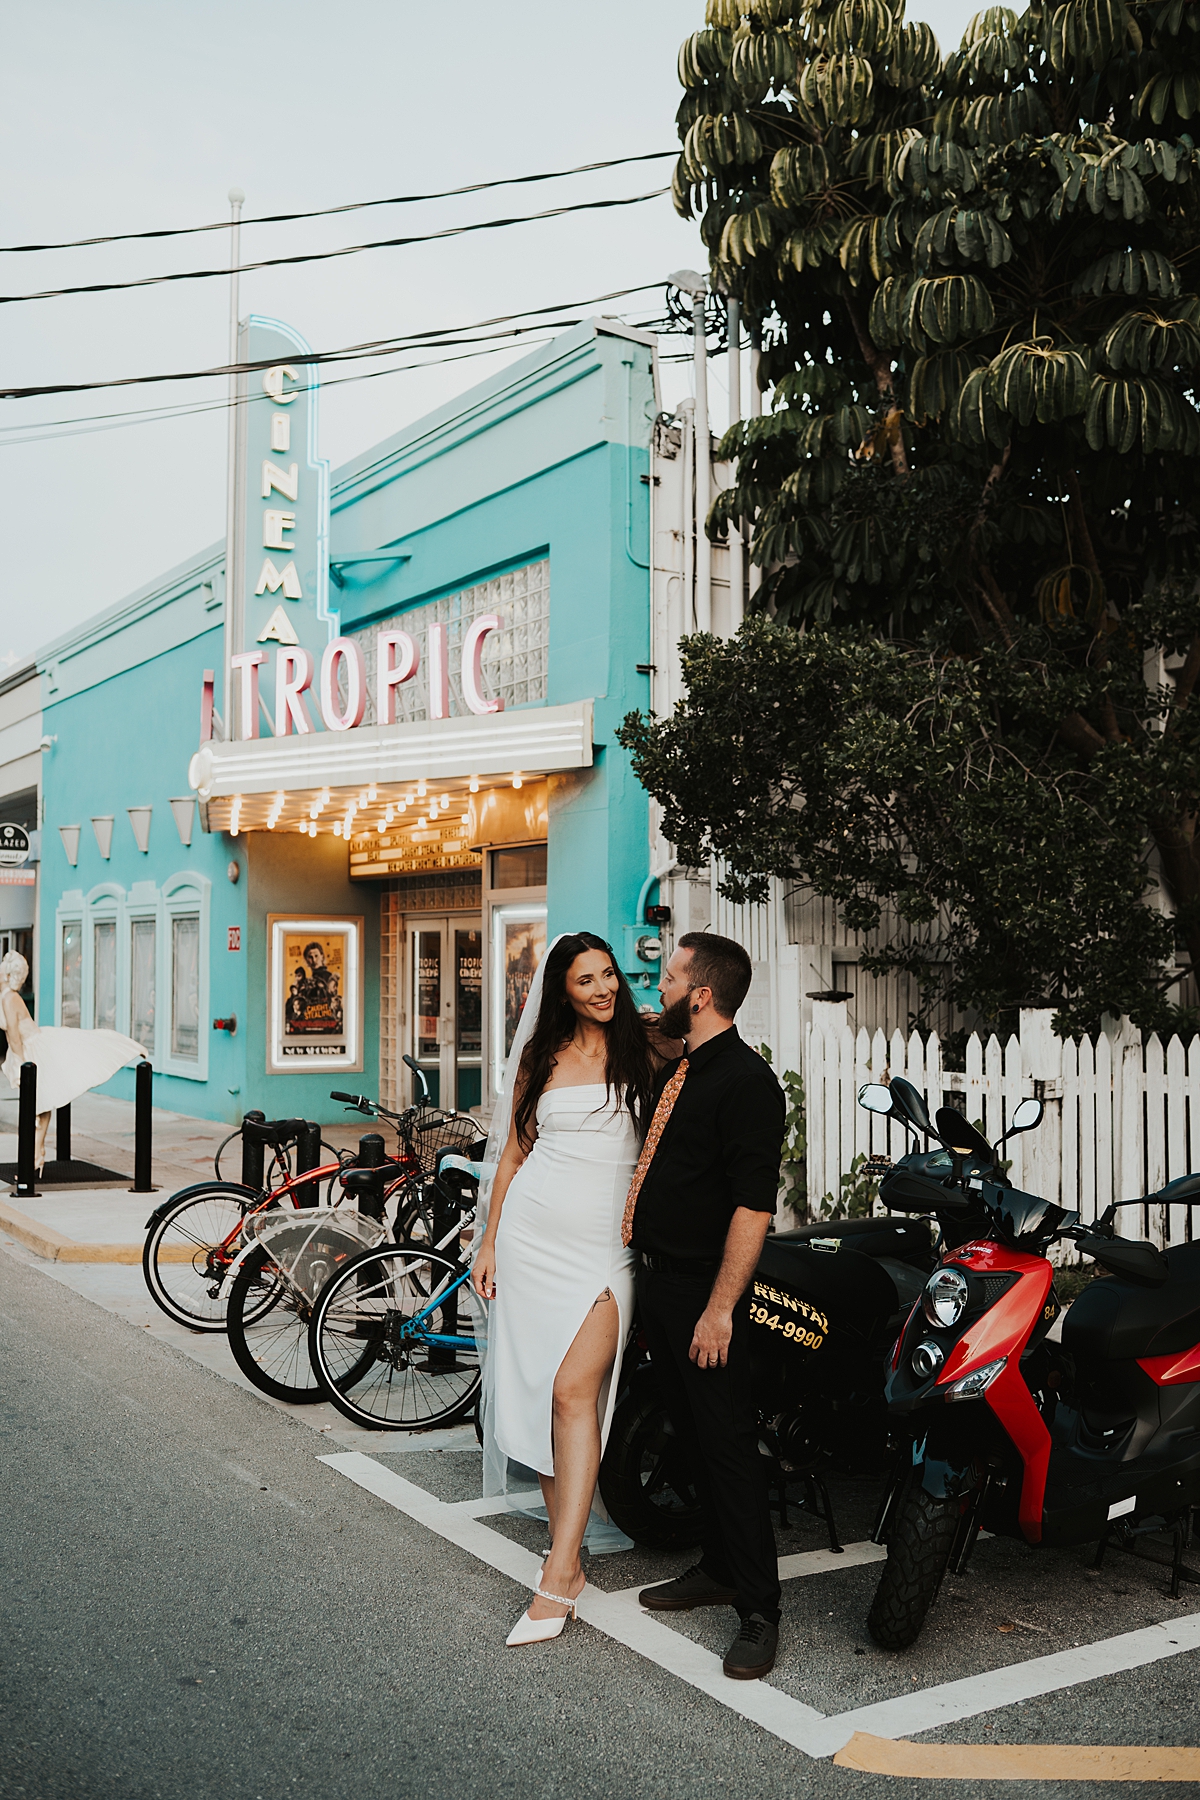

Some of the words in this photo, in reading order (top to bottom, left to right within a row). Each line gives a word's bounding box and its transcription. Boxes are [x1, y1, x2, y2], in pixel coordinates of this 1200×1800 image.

[254, 364, 302, 646] CINEMA
[231, 614, 505, 740] TROPIC
[228, 929, 240, 948] FDC
[966, 1246, 993, 1255] LANCE
[753, 1285, 829, 1335] RENTAL
[1044, 1303, 1056, 1321] 84
